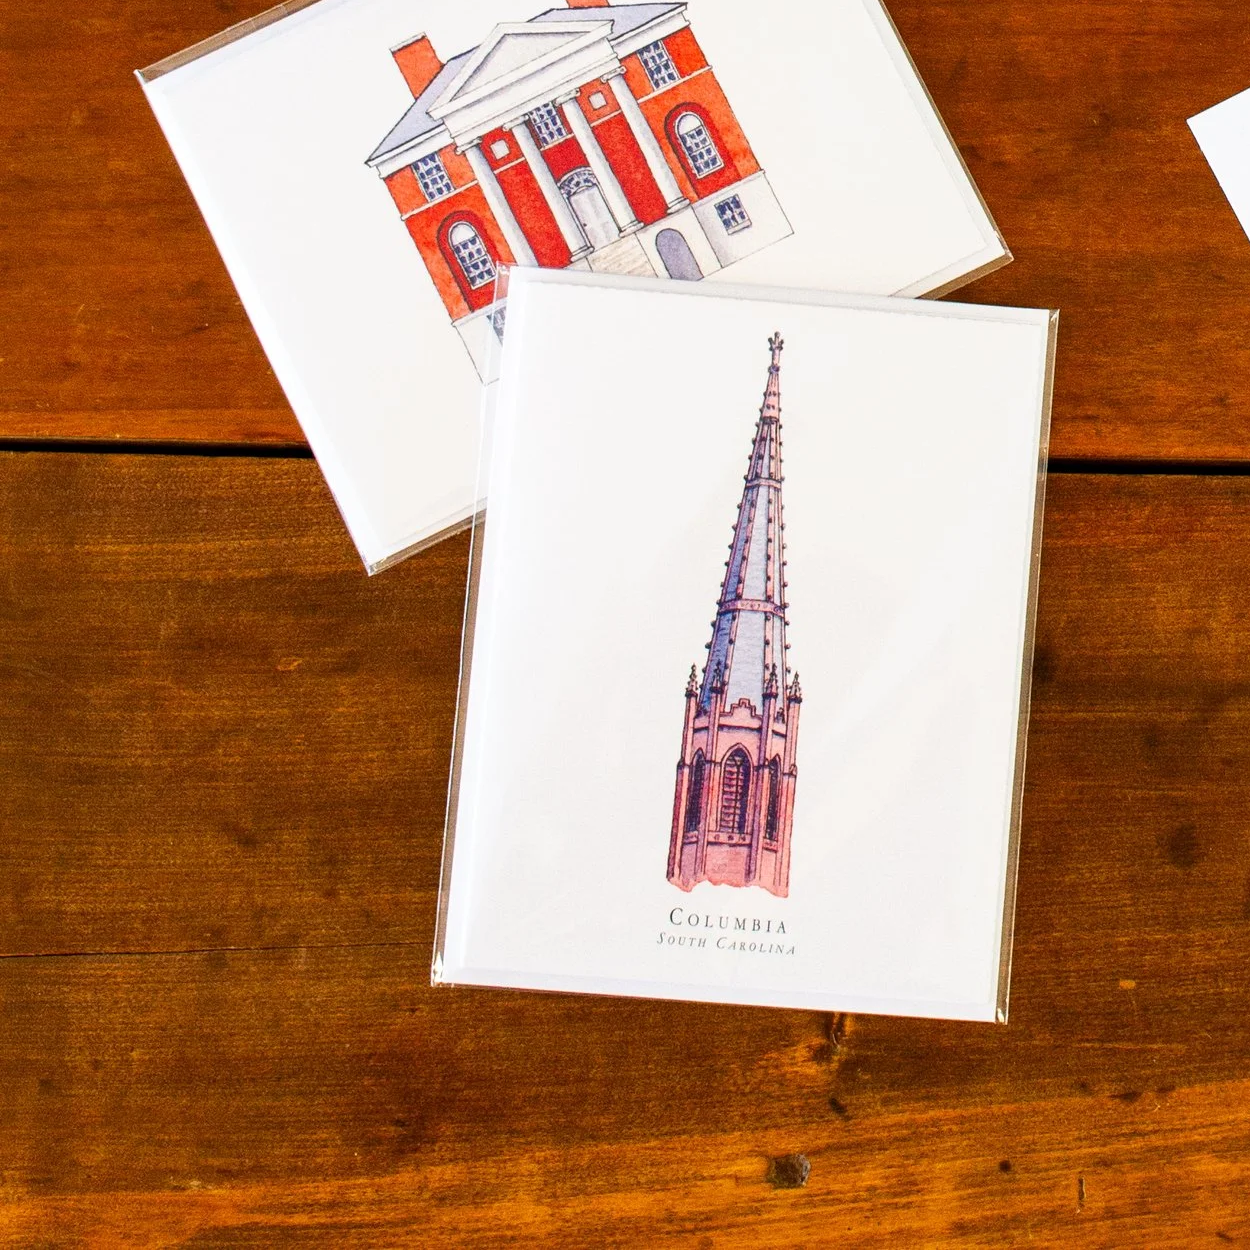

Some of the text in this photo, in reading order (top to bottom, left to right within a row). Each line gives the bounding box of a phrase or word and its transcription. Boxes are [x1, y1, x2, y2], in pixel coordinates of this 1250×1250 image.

[669, 907, 787, 934] COLUMBIA
[656, 931, 796, 956] SOUTH CAROLINA
